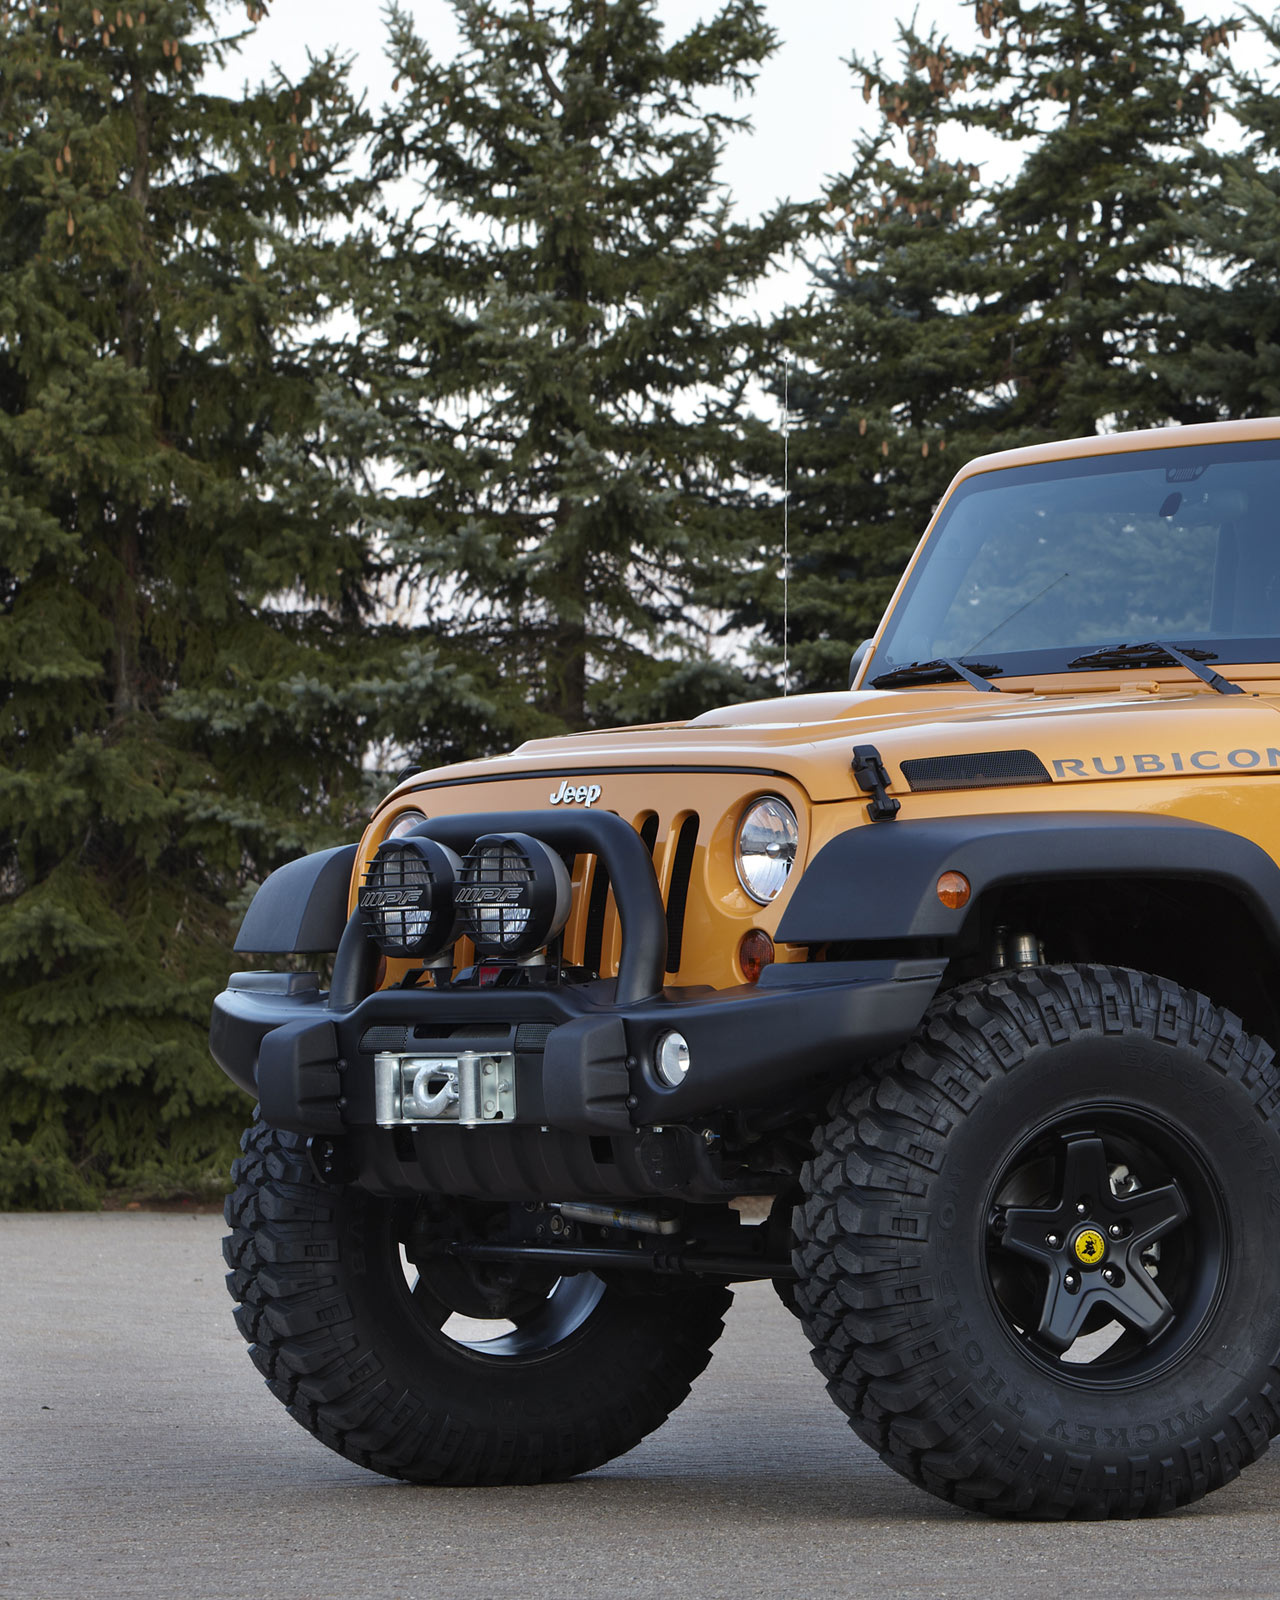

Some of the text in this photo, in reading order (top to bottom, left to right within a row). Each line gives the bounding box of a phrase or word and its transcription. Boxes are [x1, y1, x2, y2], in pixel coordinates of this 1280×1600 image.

[550, 780, 602, 808] Jeep
[1118, 1043, 1229, 1113] BAJA
[932, 1164, 1214, 1449] MICKEY THOMPSON
